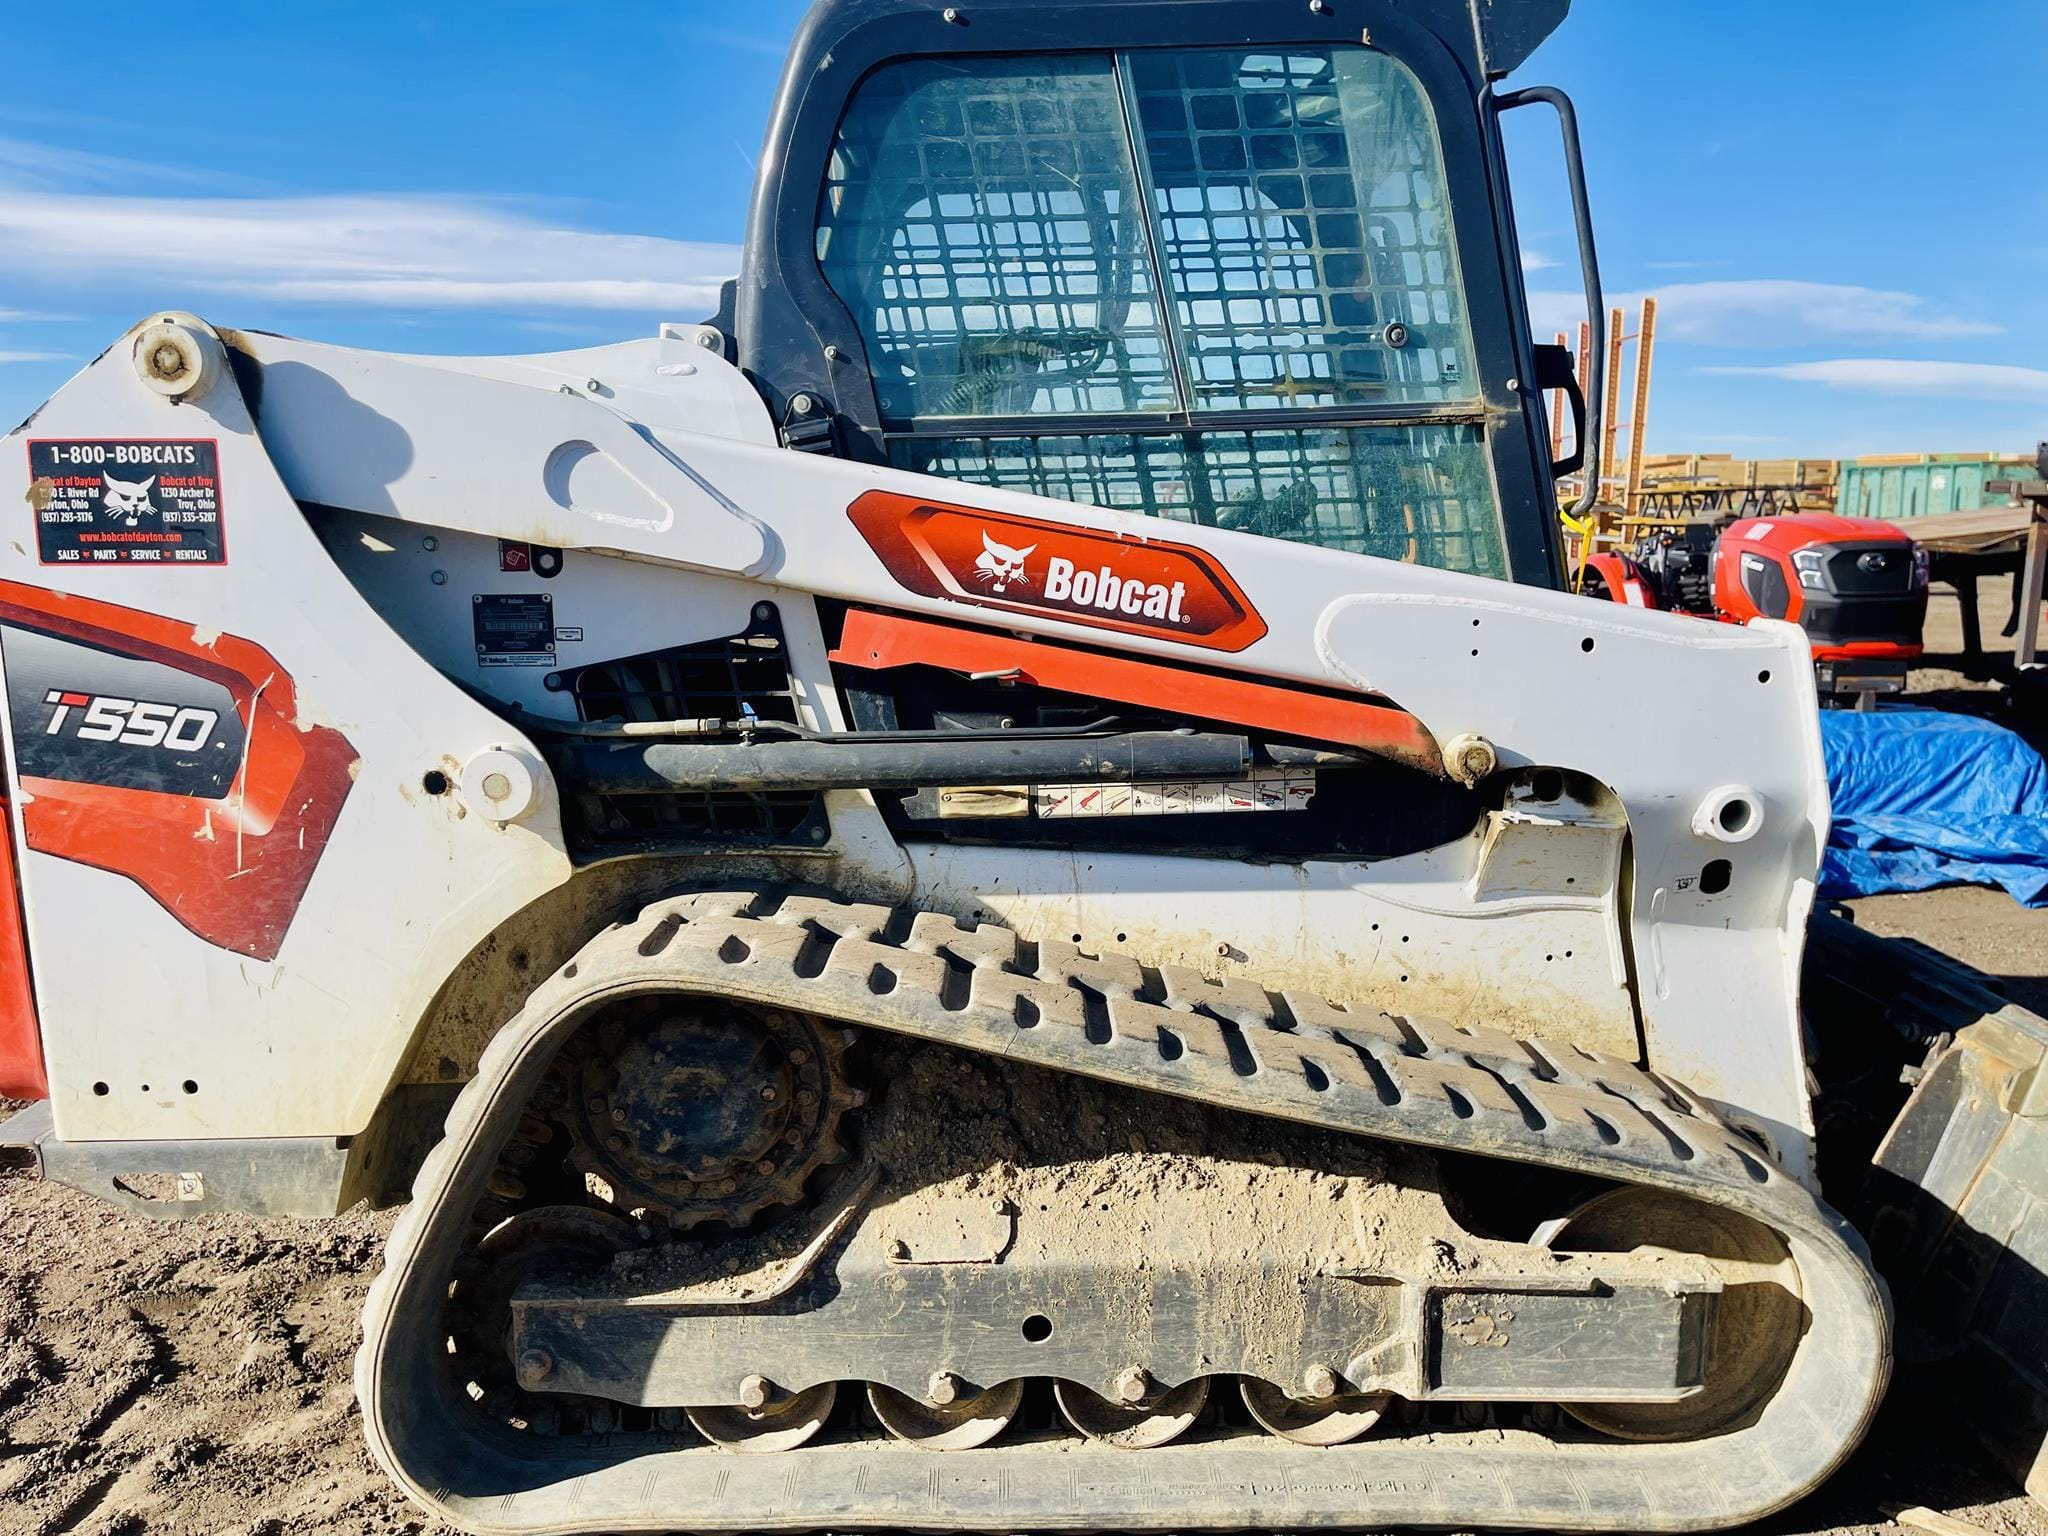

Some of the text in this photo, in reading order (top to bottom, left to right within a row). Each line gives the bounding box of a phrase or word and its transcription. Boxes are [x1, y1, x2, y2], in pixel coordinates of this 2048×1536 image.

[51, 445, 196, 464] 1-800-BOBCATS
[66, 476, 73, 486] of
[74, 476, 102, 488] Dayton
[160, 476, 214, 488] Bobcat of Troy
[58, 487, 67, 498] E.
[67, 487, 88, 498] River
[88, 487, 100, 498] Rd
[160, 487, 215, 498] 1230 Archer Dr
[71, 498, 90, 510] Ohio
[178, 498, 216, 510] Troy, Ohio
[41, 511, 60, 523] (937)
[162, 511, 216, 523] (937) 335-5287
[79, 532, 183, 543] www.bobcatofdayton.com
[57, 549, 208, 560] SALES PARTS SERVICE RENTALS
[1044, 557, 1186, 623] Bobcat
[46, 691, 218, 750] T550
